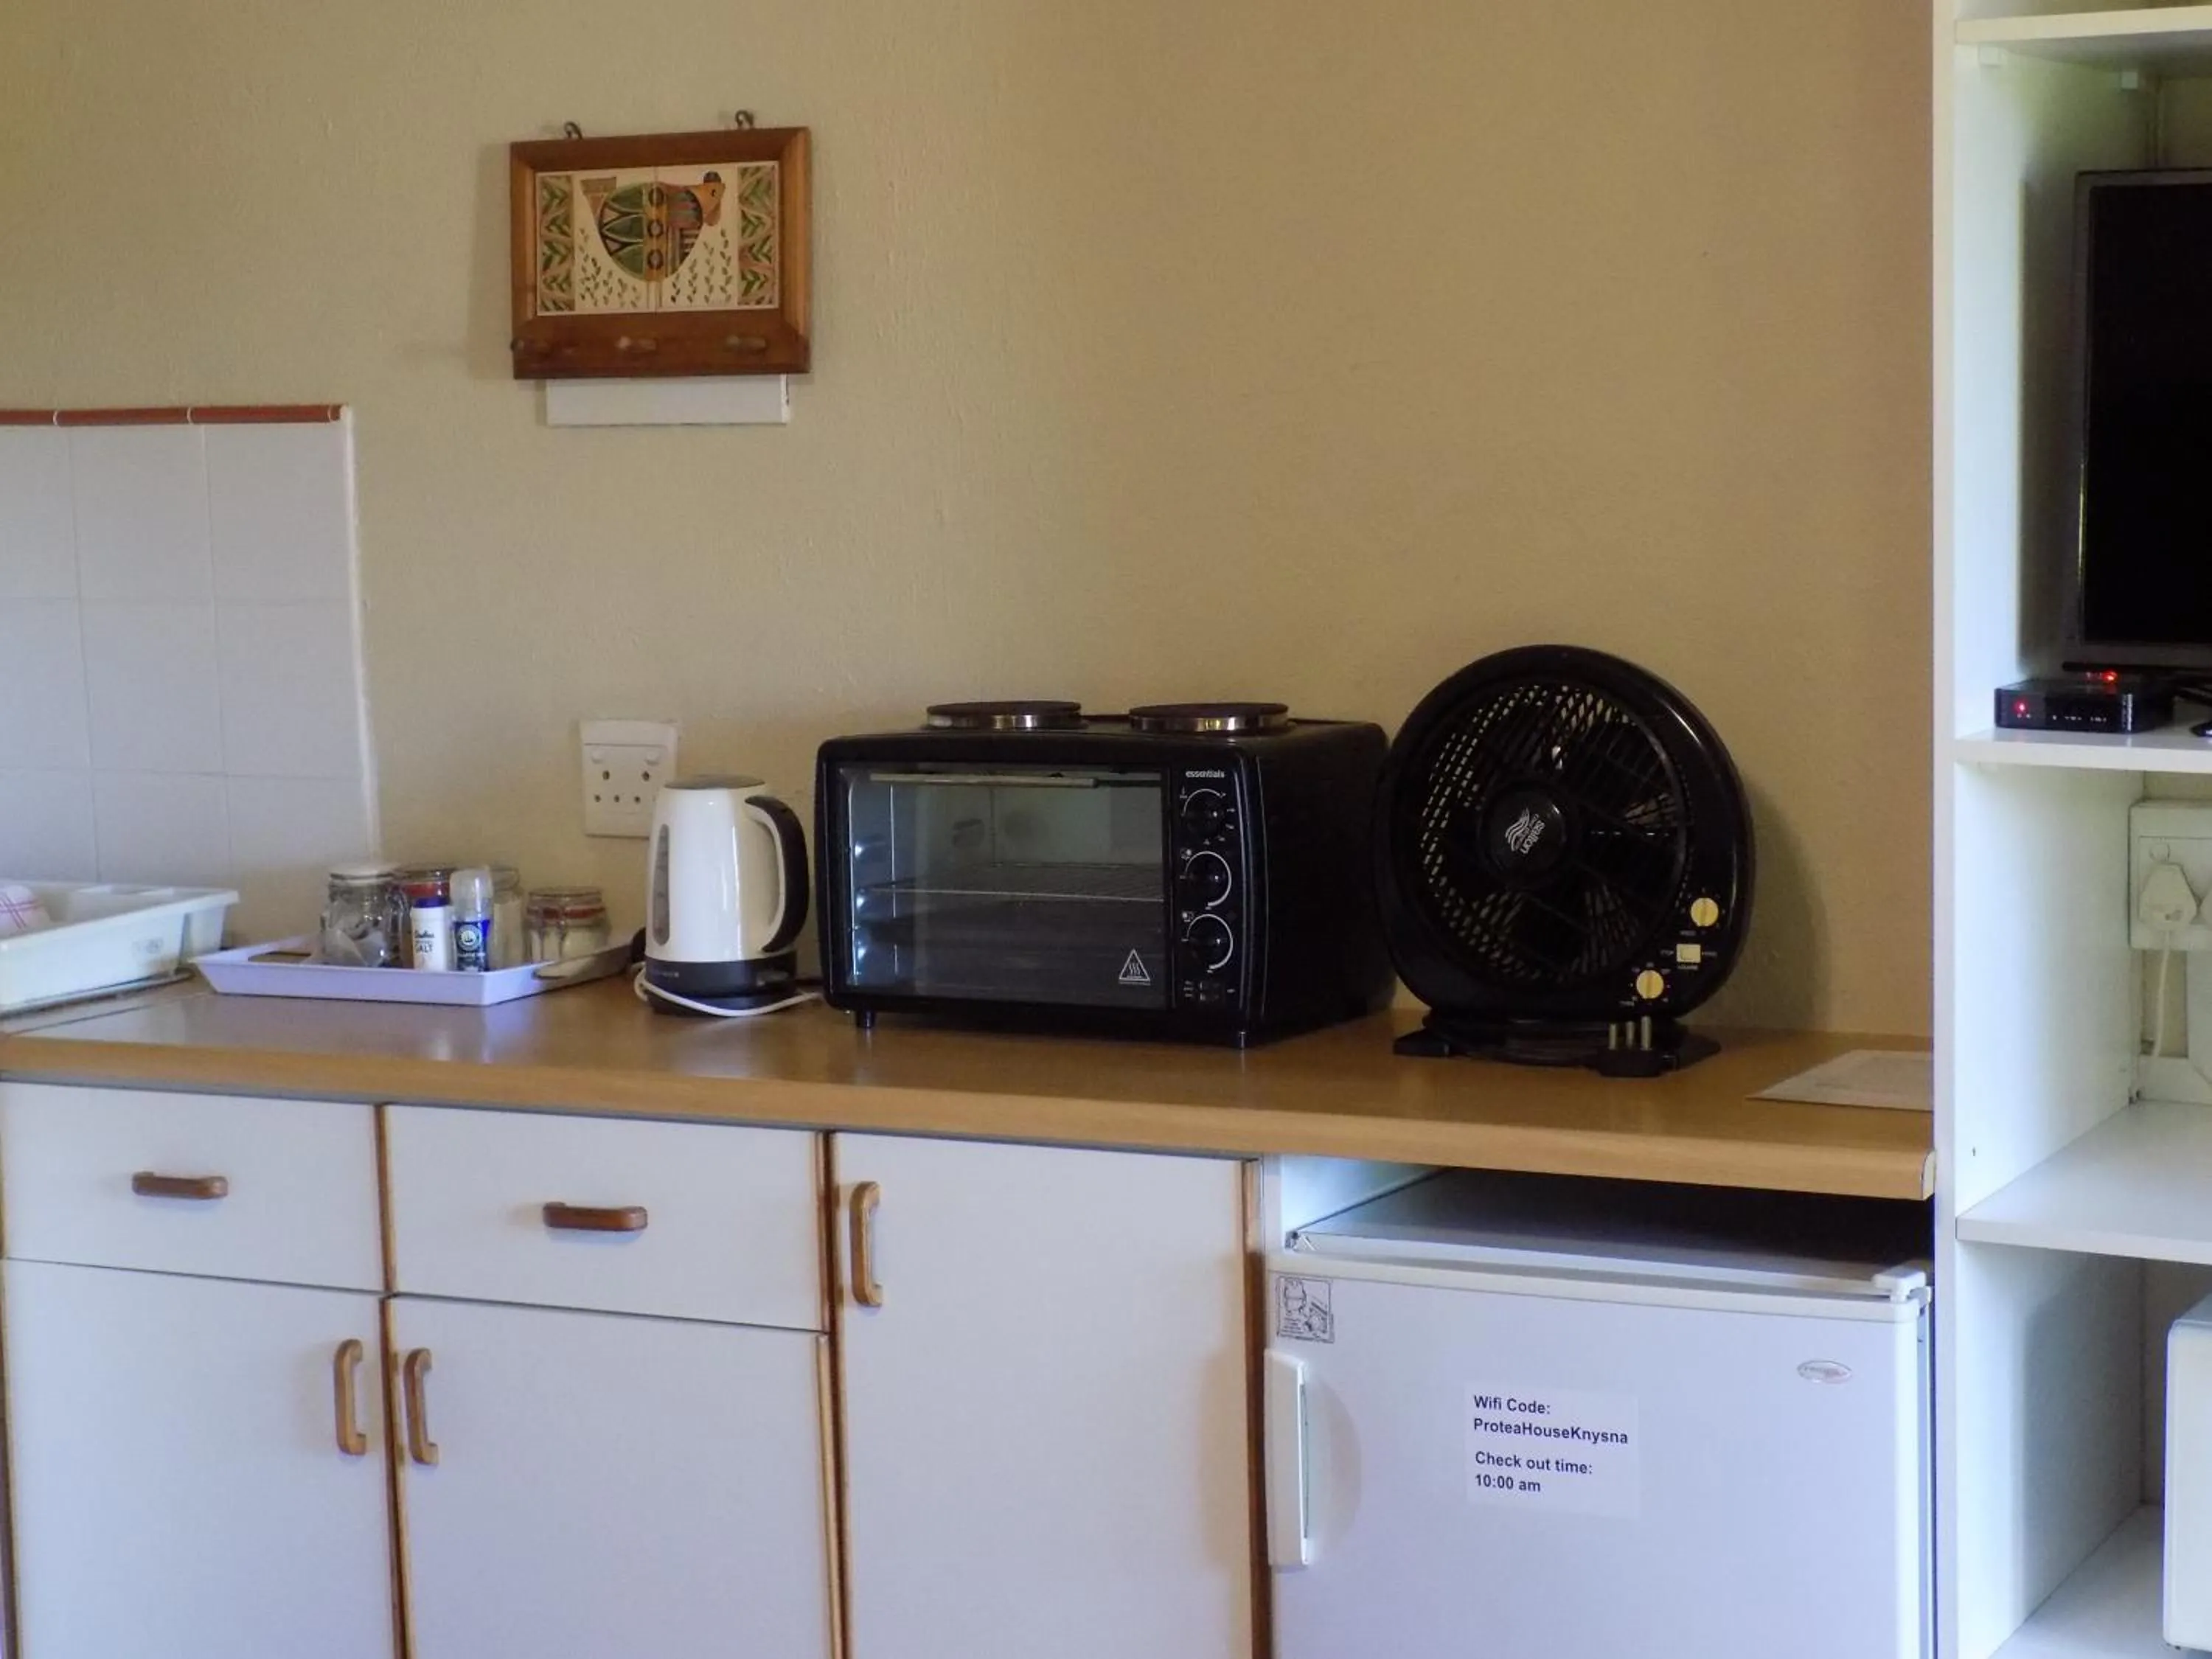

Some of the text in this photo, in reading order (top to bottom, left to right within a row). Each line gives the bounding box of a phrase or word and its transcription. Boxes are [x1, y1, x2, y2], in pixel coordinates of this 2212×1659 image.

[1185, 769, 1225, 779] essentials
[1520, 819, 1545, 854] salton
[1474, 1395, 1550, 1414] Wifi Code:
[1474, 1418, 1628, 1444] ProteaHouseKnysna
[1475, 1451, 1593, 1474] Check out time:
[1475, 1474, 1540, 1492] 10:00 am
